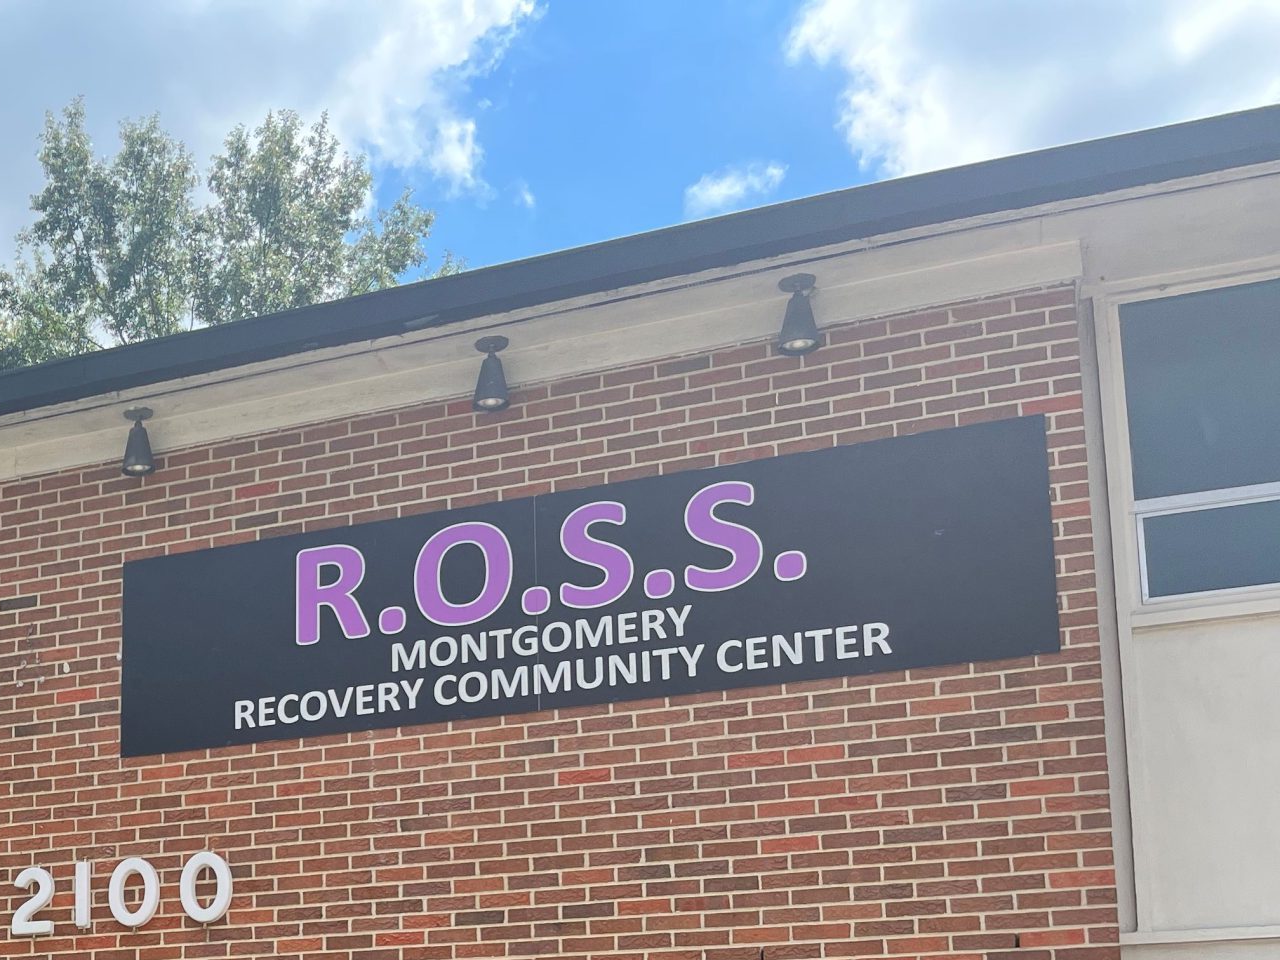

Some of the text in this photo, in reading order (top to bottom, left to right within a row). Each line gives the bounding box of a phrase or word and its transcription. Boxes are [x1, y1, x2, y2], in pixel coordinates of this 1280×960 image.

[296, 481, 807, 646] R.O.S.S.
[234, 621, 893, 730] RECOVERY COMMUNITY CENTER
[391, 604, 693, 673] MONTGOMERY
[11, 850, 233, 935] 2100
